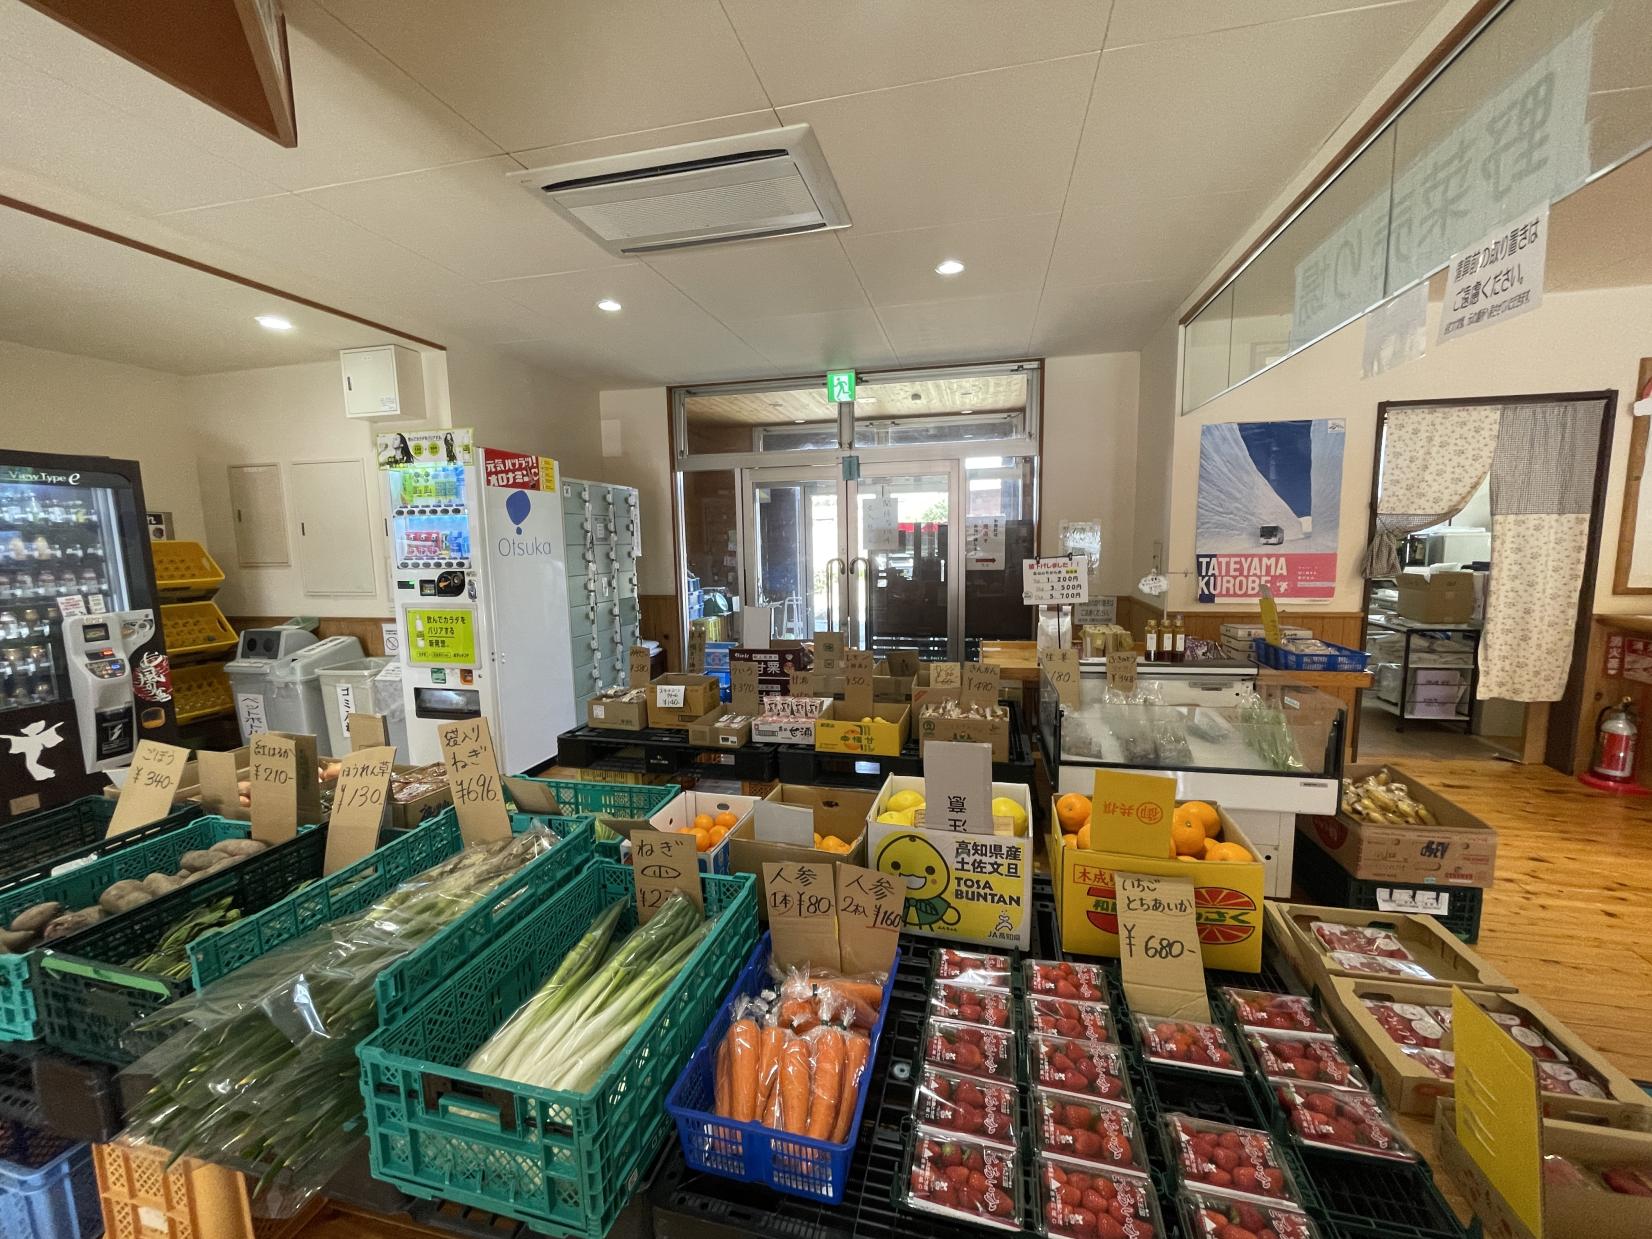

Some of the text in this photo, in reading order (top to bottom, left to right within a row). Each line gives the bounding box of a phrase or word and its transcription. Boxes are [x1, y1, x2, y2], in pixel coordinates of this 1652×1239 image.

[41, 472, 66, 483] Type
[488, 468, 539, 487] オロナミンC
[498, 537, 551, 557] Otsuka
[1199, 557, 1287, 576] TATEYAMA
[426, 615, 466, 624] 飲んでカラダを
[427, 626, 455, 635] バリアする
[143, 748, 174, 765] ごぼう
[254, 739, 296, 759] 紅はるか
[451, 746, 487, 773] ねぎ
[342, 760, 391, 778] ほうれん草
[637, 839, 684, 857] ねぎ
[955, 839, 1022, 861] 高知県産
[770, 866, 817, 887] 人参
[955, 858, 1021, 878] 土佐文旦
[845, 874, 895, 901] 人参
[955, 877, 994, 892] TOSA
[1122, 878, 1160, 892] いちご
[955, 890, 1022, 907] BUNTAN
[1127, 896, 1194, 912] とちあいか
